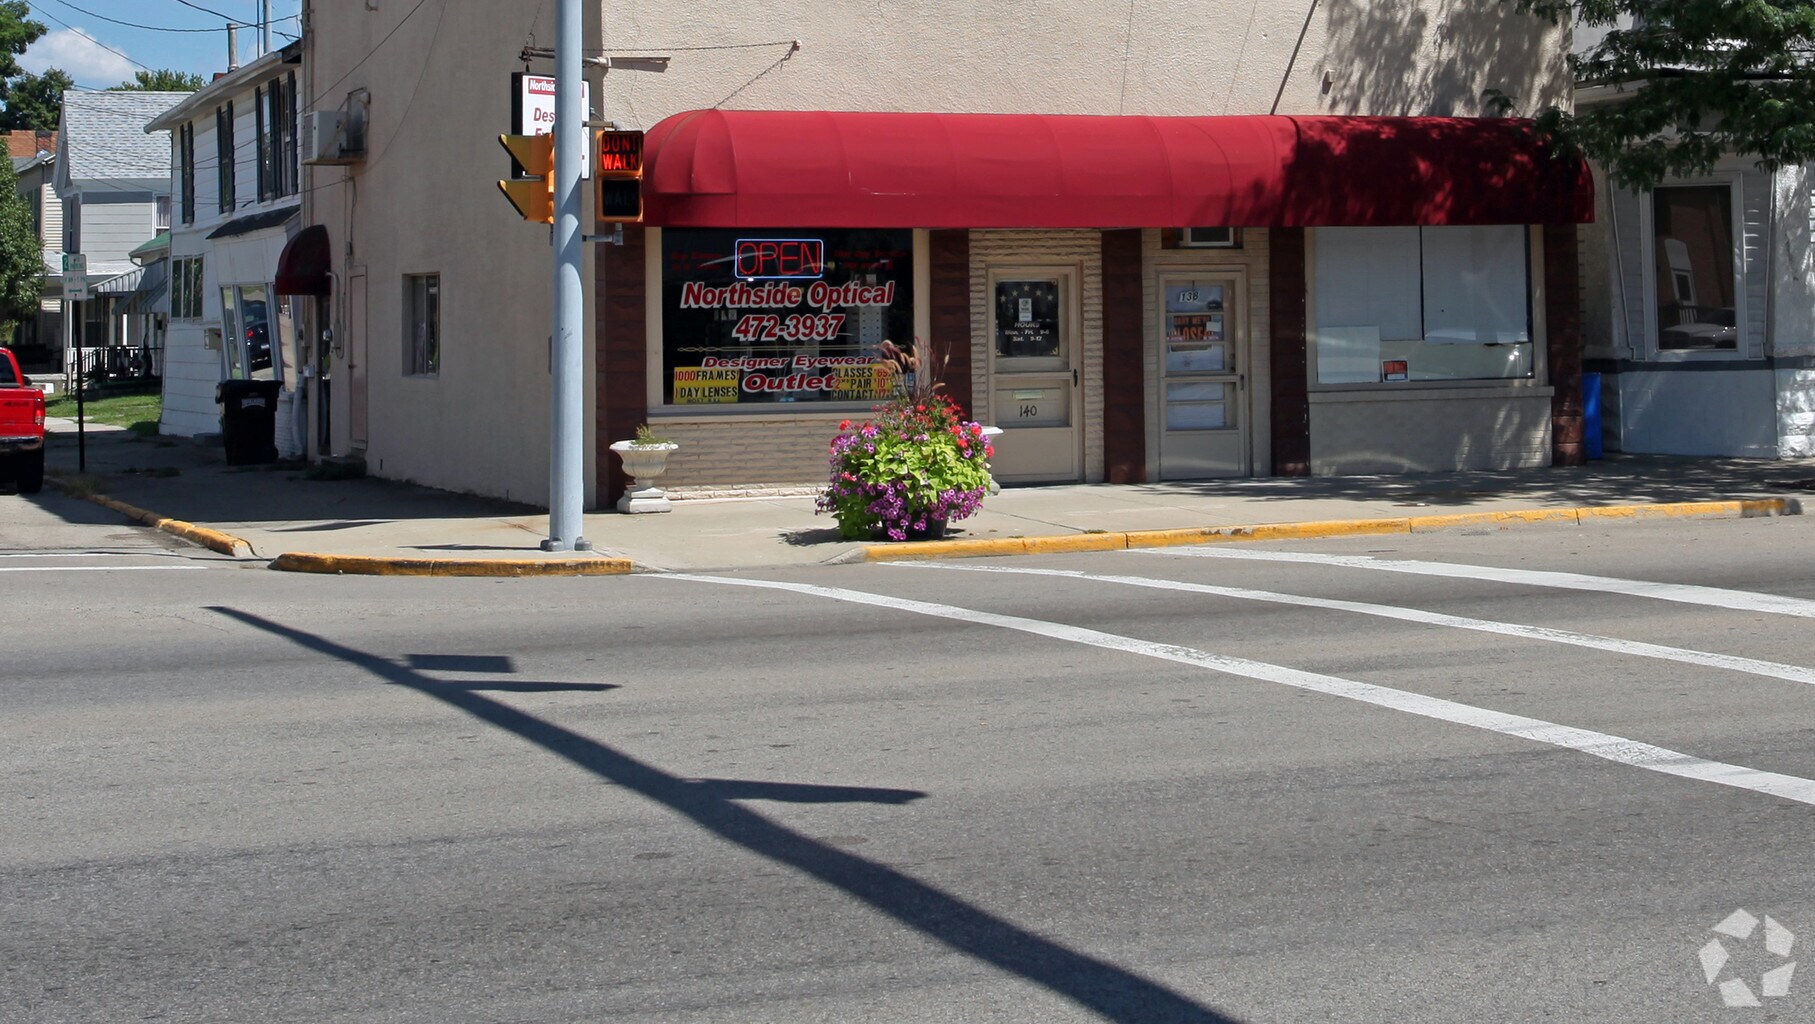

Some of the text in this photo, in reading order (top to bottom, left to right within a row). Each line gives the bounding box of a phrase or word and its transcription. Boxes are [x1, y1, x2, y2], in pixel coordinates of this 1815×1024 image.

[602, 154, 637, 170] WALK
[738, 242, 821, 274] OPEN
[680, 280, 895, 312] Northside Optical
[732, 314, 845, 341] 472-3937
[702, 355, 875, 372] Designer Eyewear
[742, 372, 836, 393] Outlet
[851, 378, 871, 389] PAIR
[680, 387, 699, 398] DAY
[702, 386, 738, 398] LENSES
[1019, 405, 1037, 417] 140
